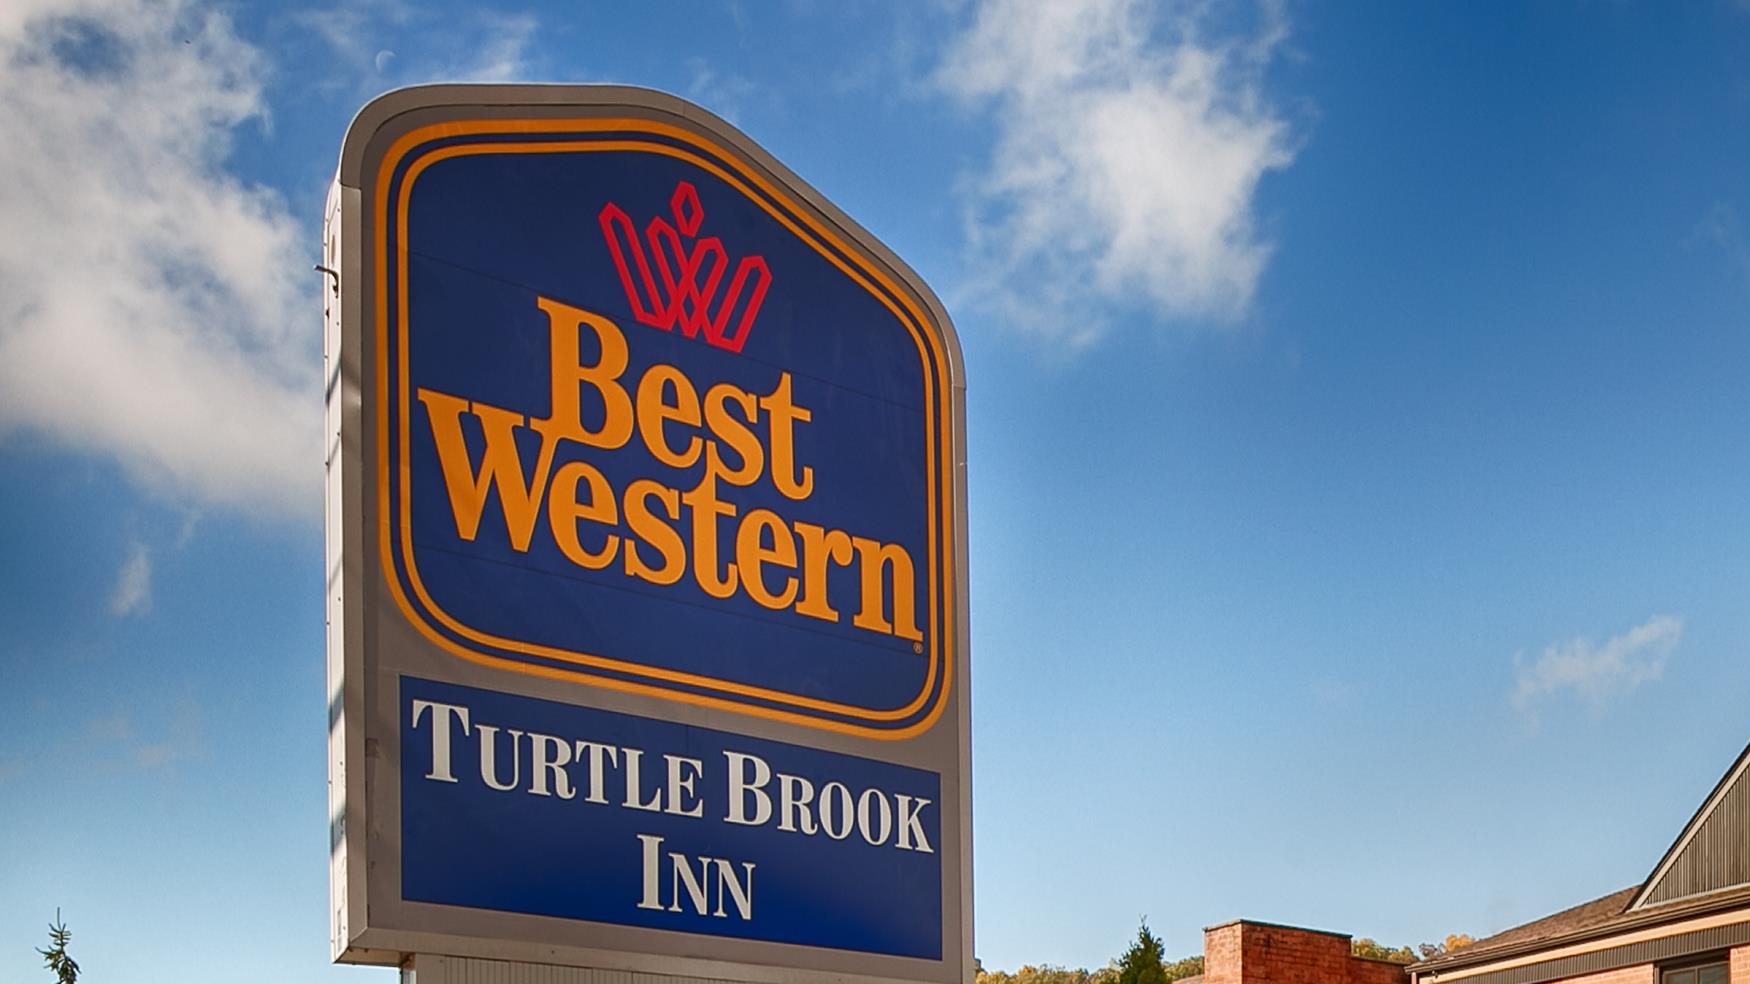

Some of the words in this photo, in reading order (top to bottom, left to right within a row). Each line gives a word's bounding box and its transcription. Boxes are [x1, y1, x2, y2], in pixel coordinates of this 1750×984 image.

[537, 296, 814, 500] Best
[417, 388, 923, 641] Western
[412, 699, 703, 818] TURTLE
[722, 750, 934, 853] BROOK
[637, 834, 756, 920] INN
